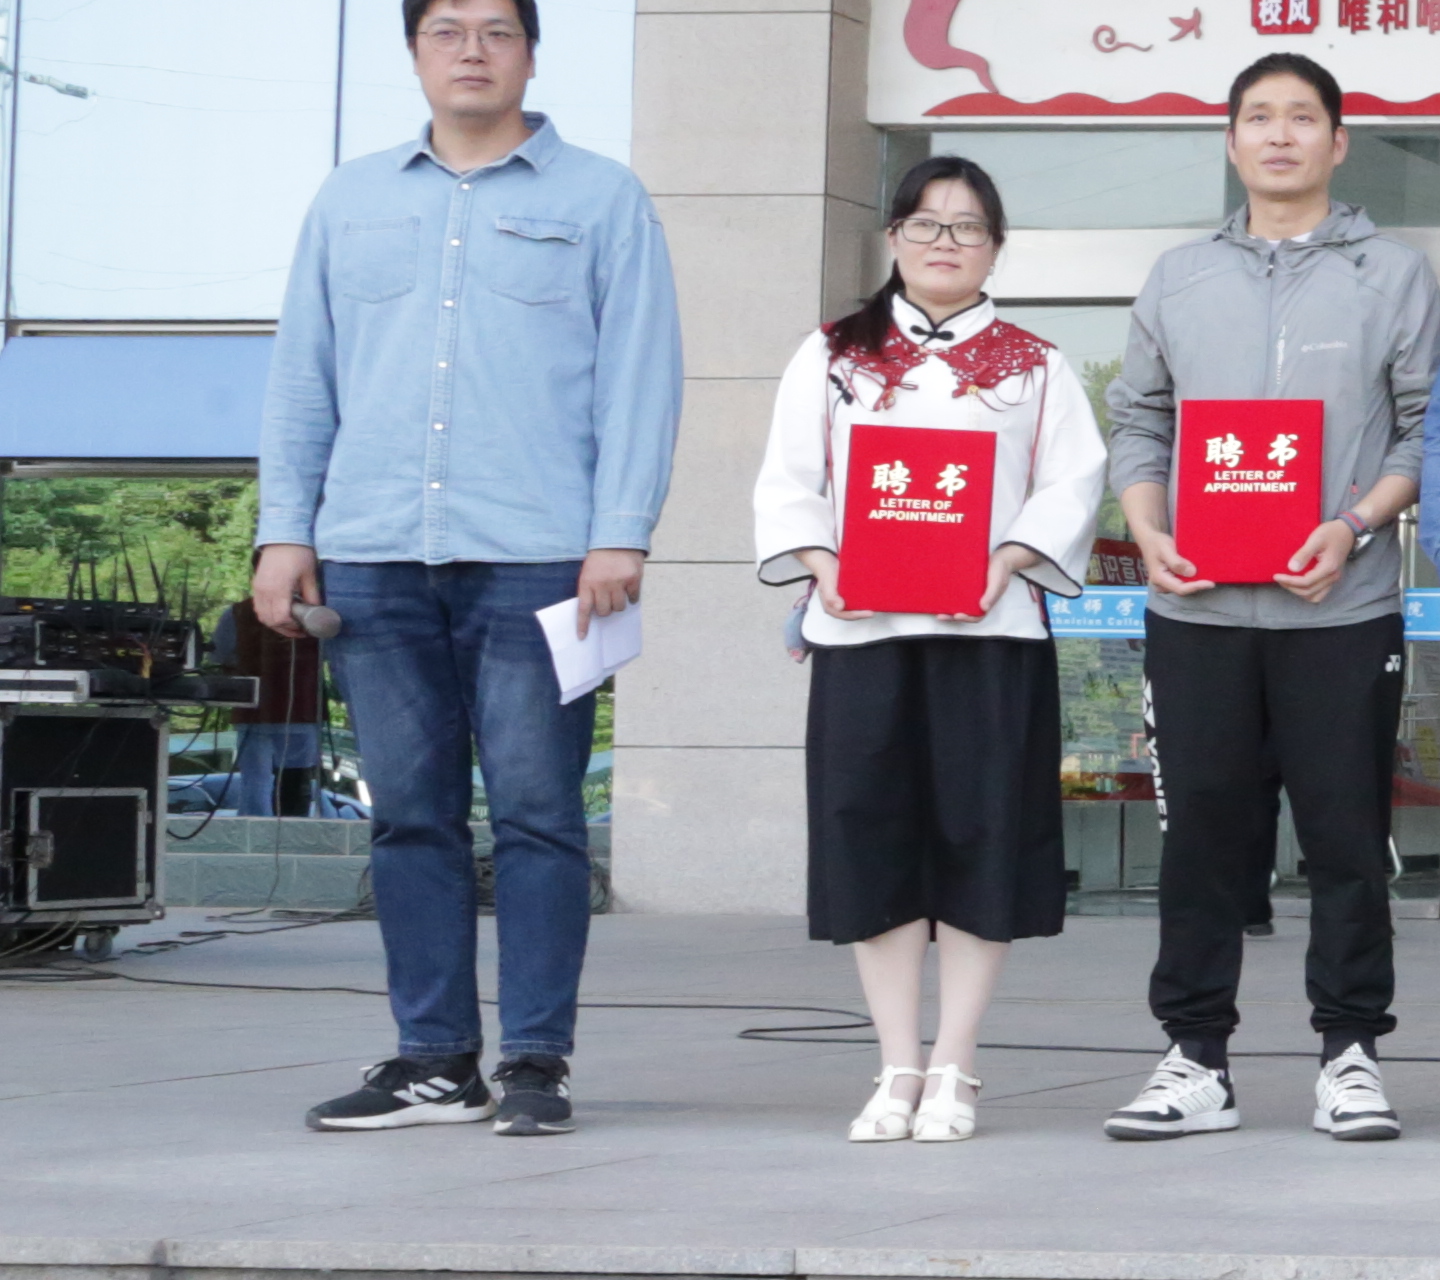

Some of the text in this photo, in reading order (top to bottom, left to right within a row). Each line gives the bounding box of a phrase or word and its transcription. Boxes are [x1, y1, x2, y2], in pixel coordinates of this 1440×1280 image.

[1206, 433, 1298, 468] 聘书
[872, 460, 968, 497] 聘书
[1215, 470, 1284, 480] LETTER OF
[1204, 482, 1296, 492] APPOINTMENT
[880, 498, 952, 510] LETTER OF
[869, 510, 964, 523] APPOINTMENT
